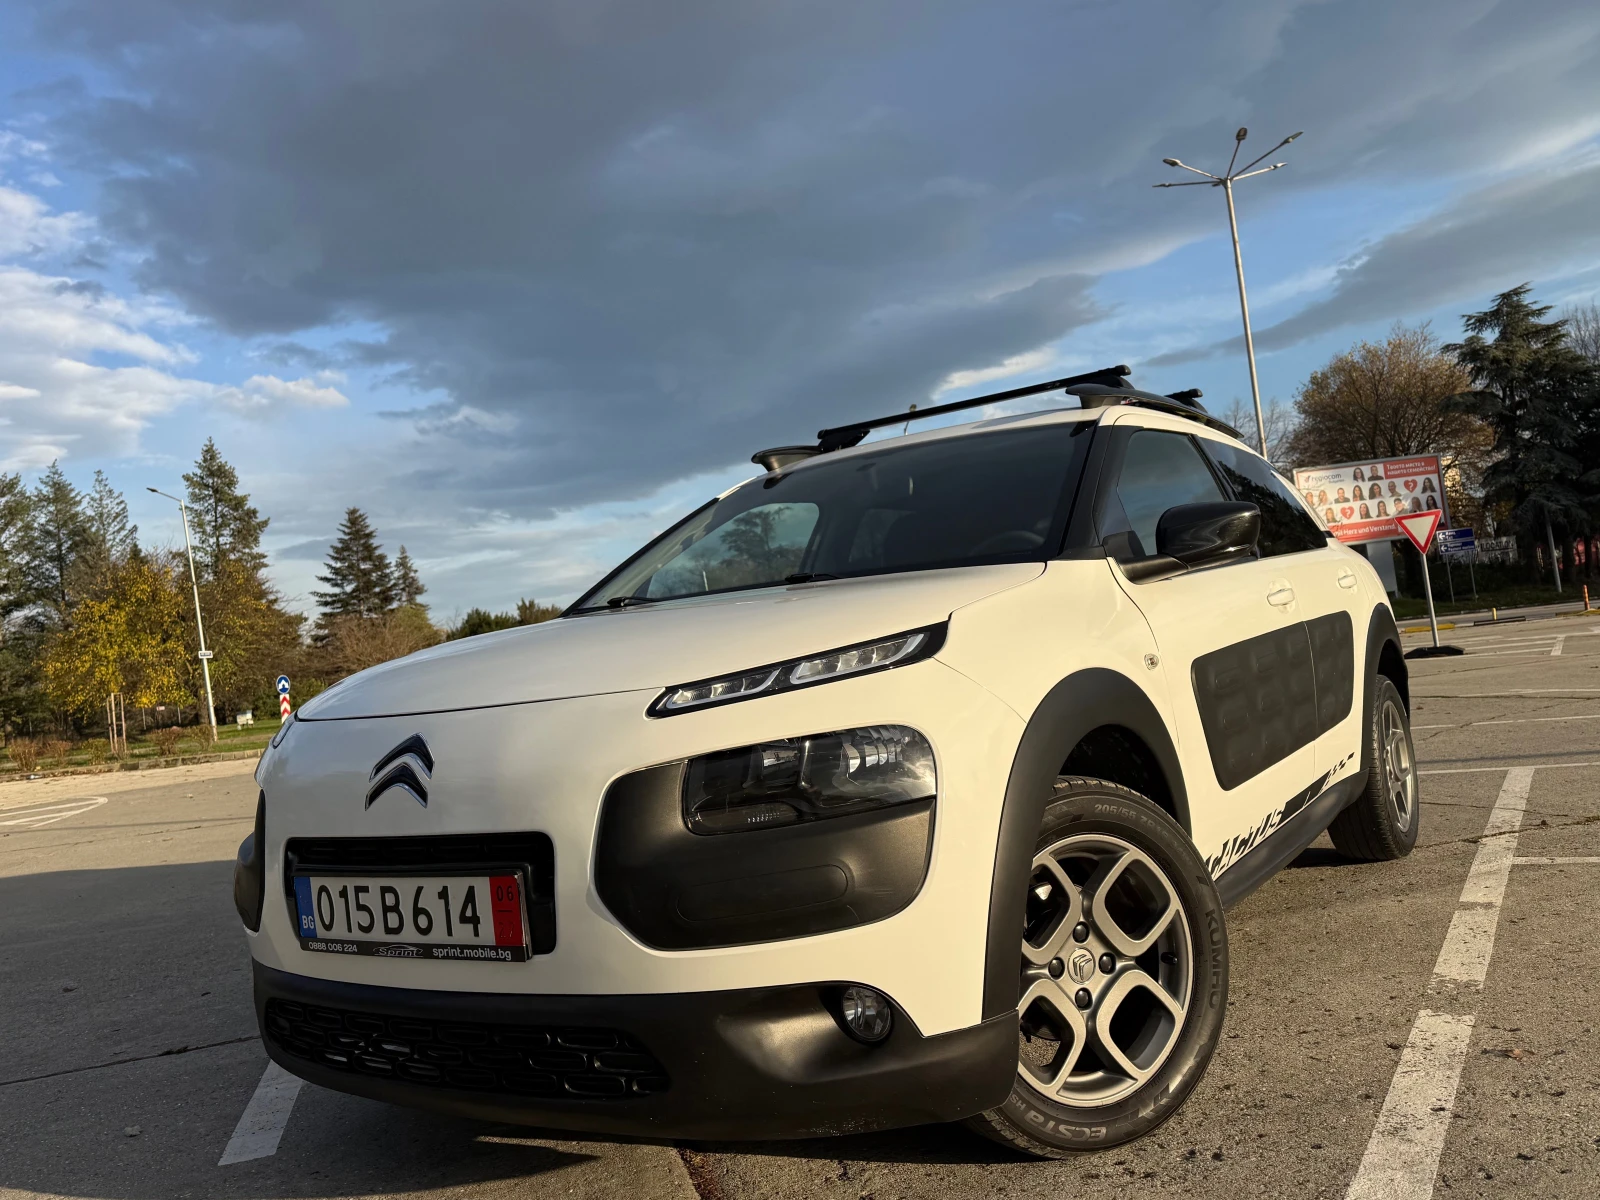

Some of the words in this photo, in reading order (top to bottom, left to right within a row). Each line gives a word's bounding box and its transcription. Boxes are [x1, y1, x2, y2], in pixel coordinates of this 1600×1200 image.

[1094, 804, 1137, 820] 205/55
[496, 885, 514, 902] 06
[317, 885, 480, 938] 015B614
[302, 915, 315, 929] BG
[309, 941, 326, 951] 0888
[328, 943, 343, 952] 006
[344, 944, 358, 953] 224
[378, 947, 418, 957] Sprint
[433, 947, 512, 961] sprint.mobile.bg
[1205, 908, 1222, 1010] KUMHO
